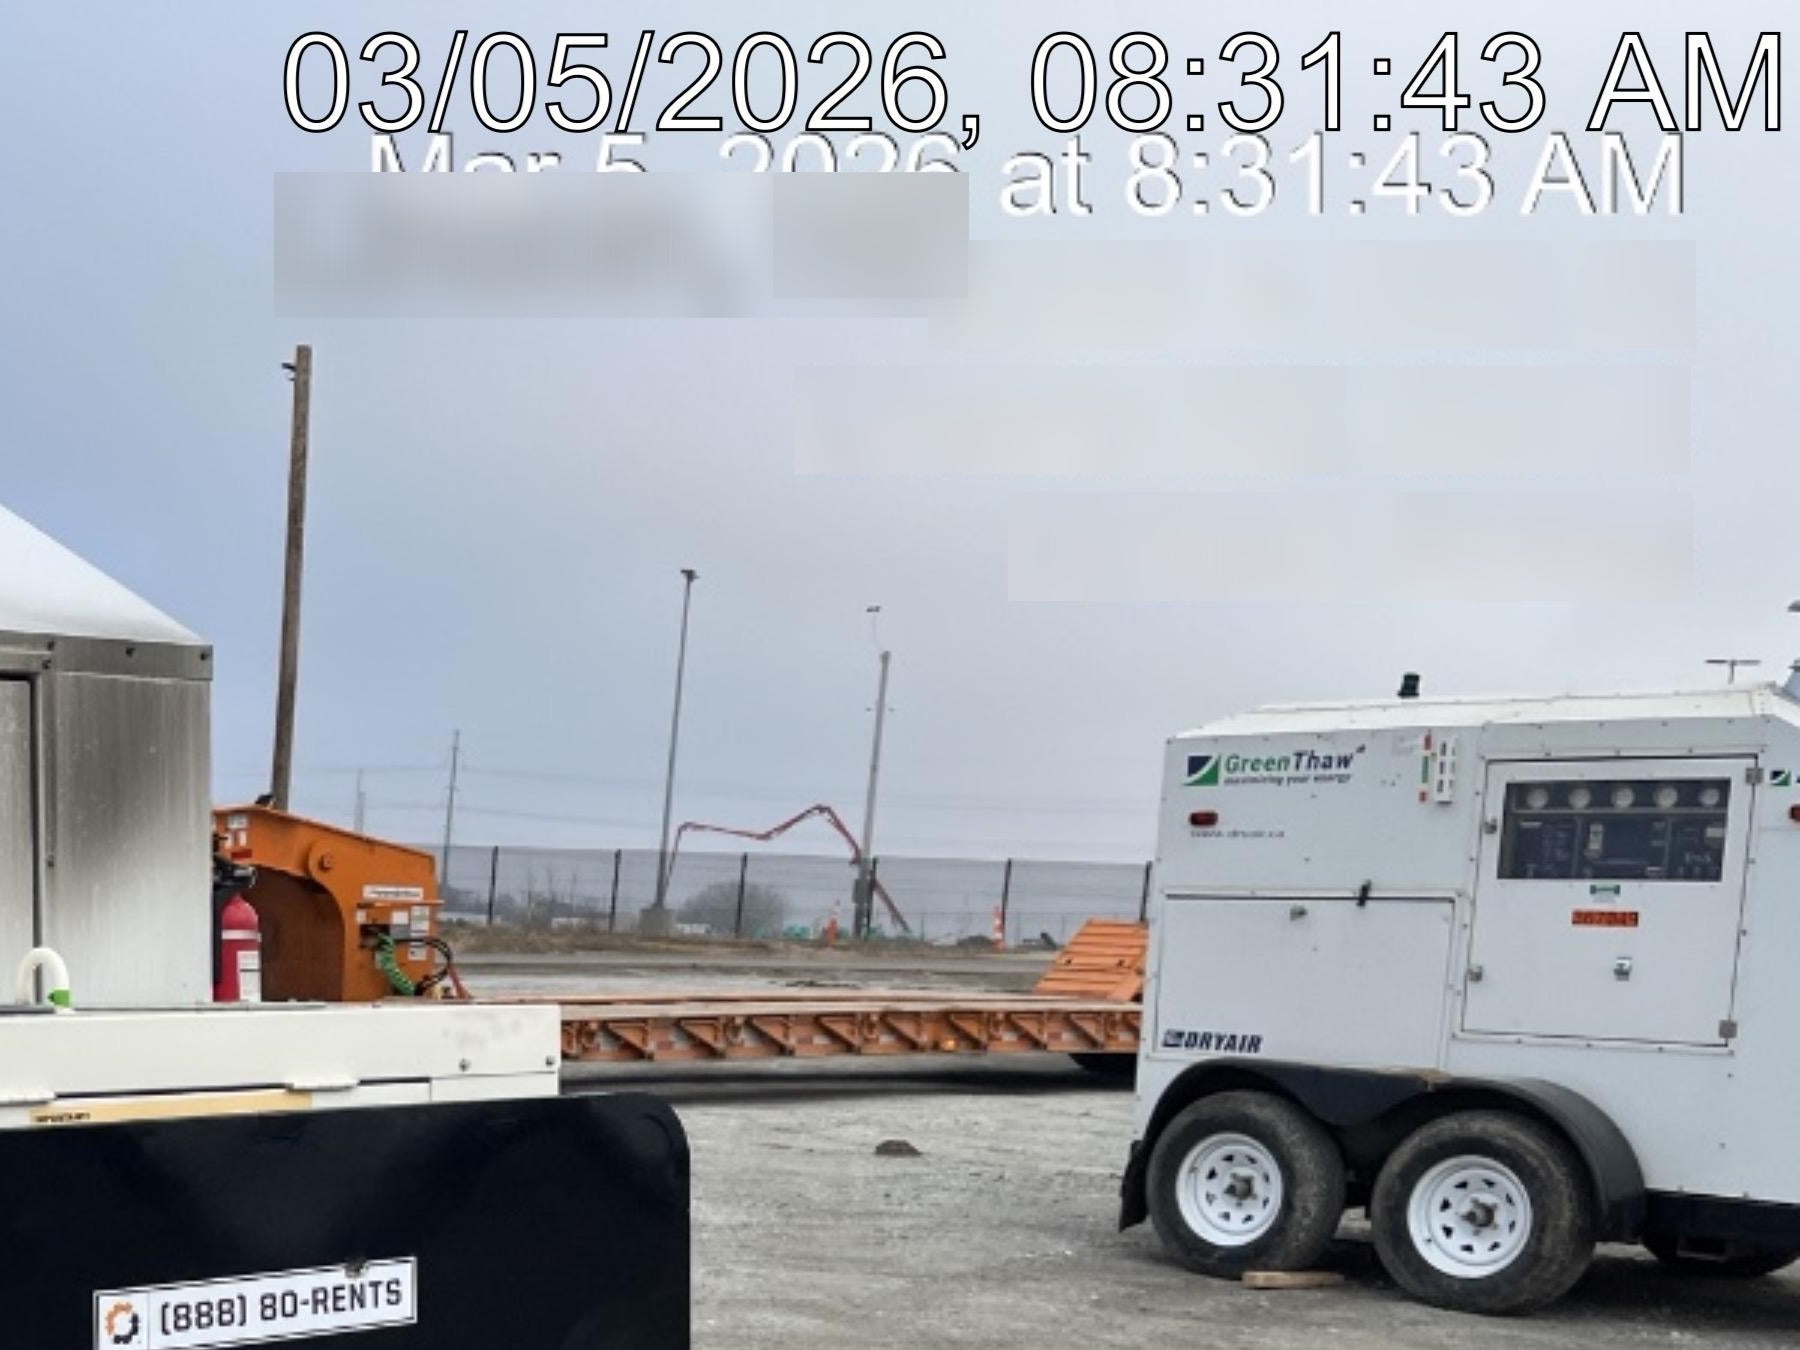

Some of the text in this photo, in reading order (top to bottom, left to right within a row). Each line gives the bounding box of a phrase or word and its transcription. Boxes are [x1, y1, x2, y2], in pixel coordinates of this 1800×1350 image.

[1224, 750, 1354, 774] GreenThaw
[1184, 1031, 1263, 1053] DRYAIR
[160, 1277, 402, 1336] (888) 80-RENTS
